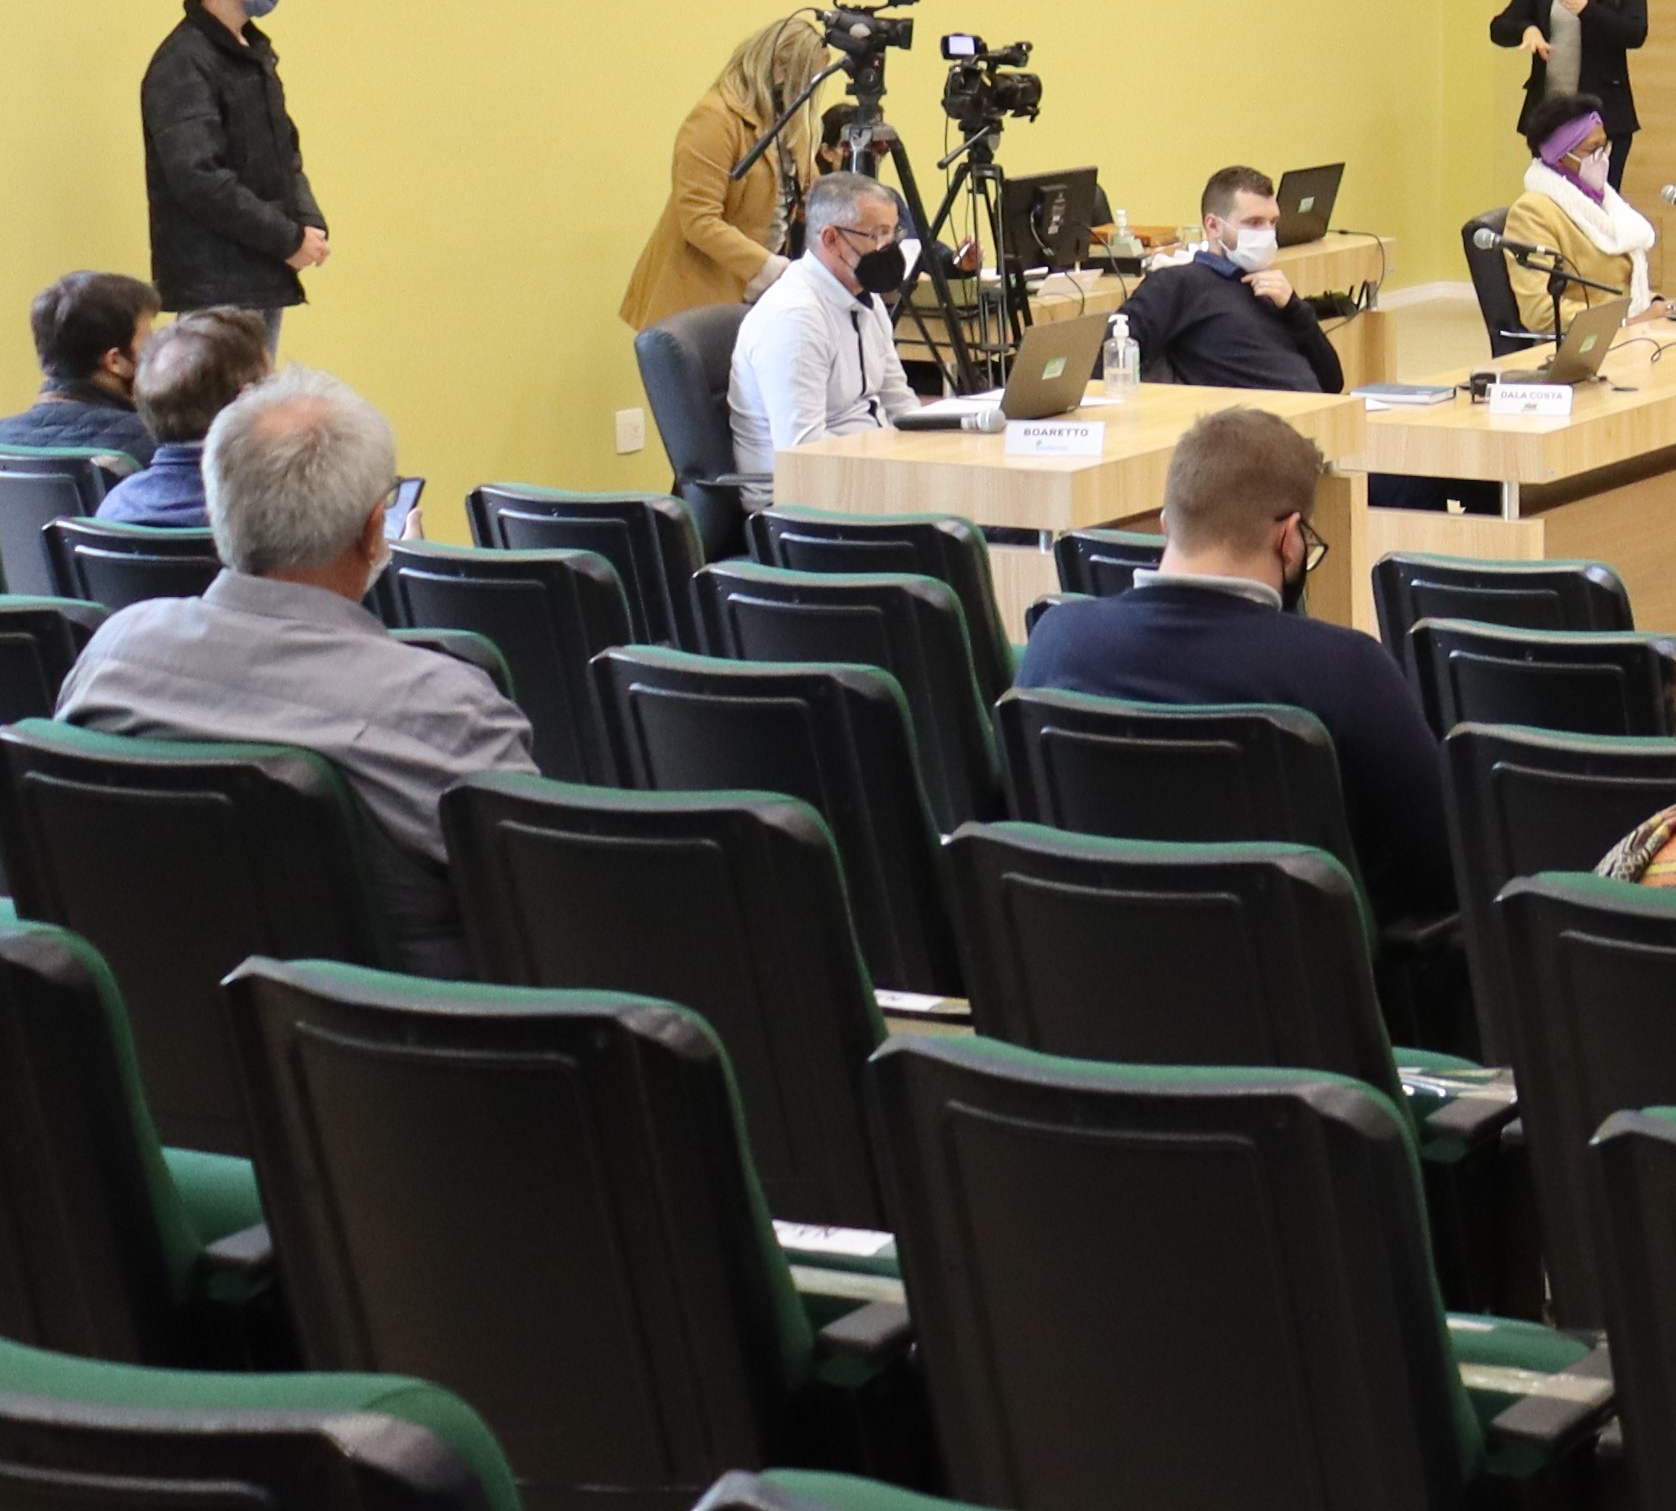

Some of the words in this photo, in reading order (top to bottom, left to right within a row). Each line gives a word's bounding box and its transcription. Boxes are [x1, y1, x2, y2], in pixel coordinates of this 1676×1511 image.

[1501, 391, 1527, 399] DALA
[1529, 391, 1563, 399] COSTA
[1024, 428, 1088, 437] BOARETTO
